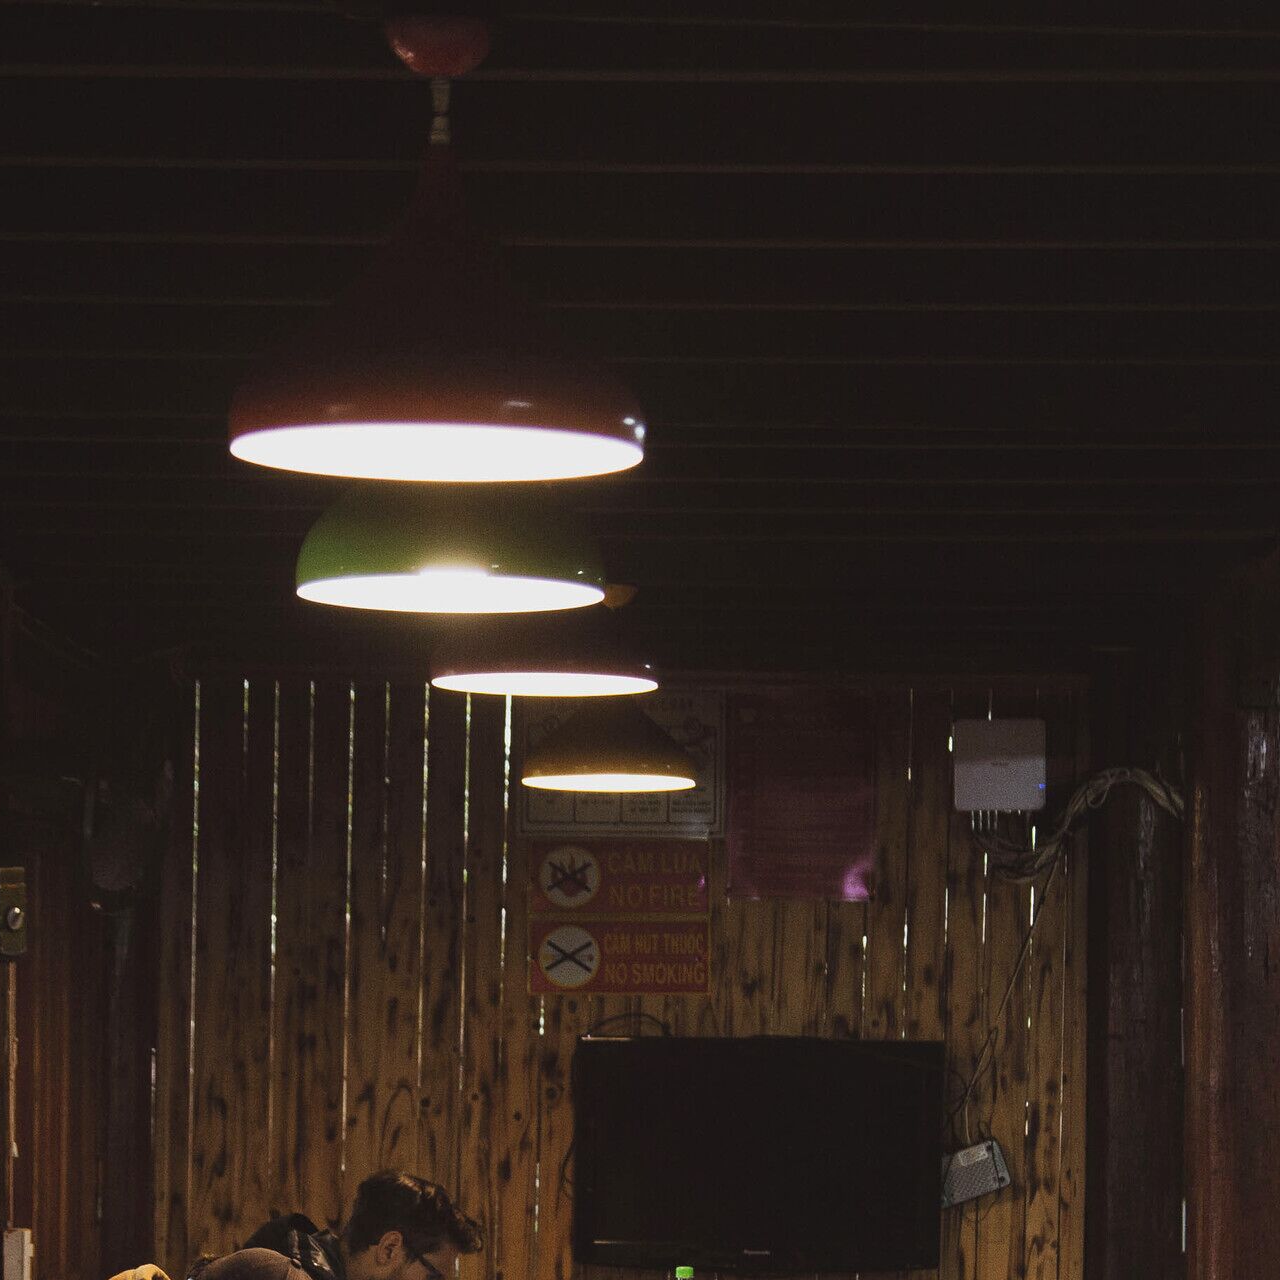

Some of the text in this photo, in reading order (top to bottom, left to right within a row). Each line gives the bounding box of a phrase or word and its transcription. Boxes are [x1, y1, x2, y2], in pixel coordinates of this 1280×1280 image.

[609, 884, 702, 908] NO FIRE
[604, 961, 705, 985] NO SMOKING
